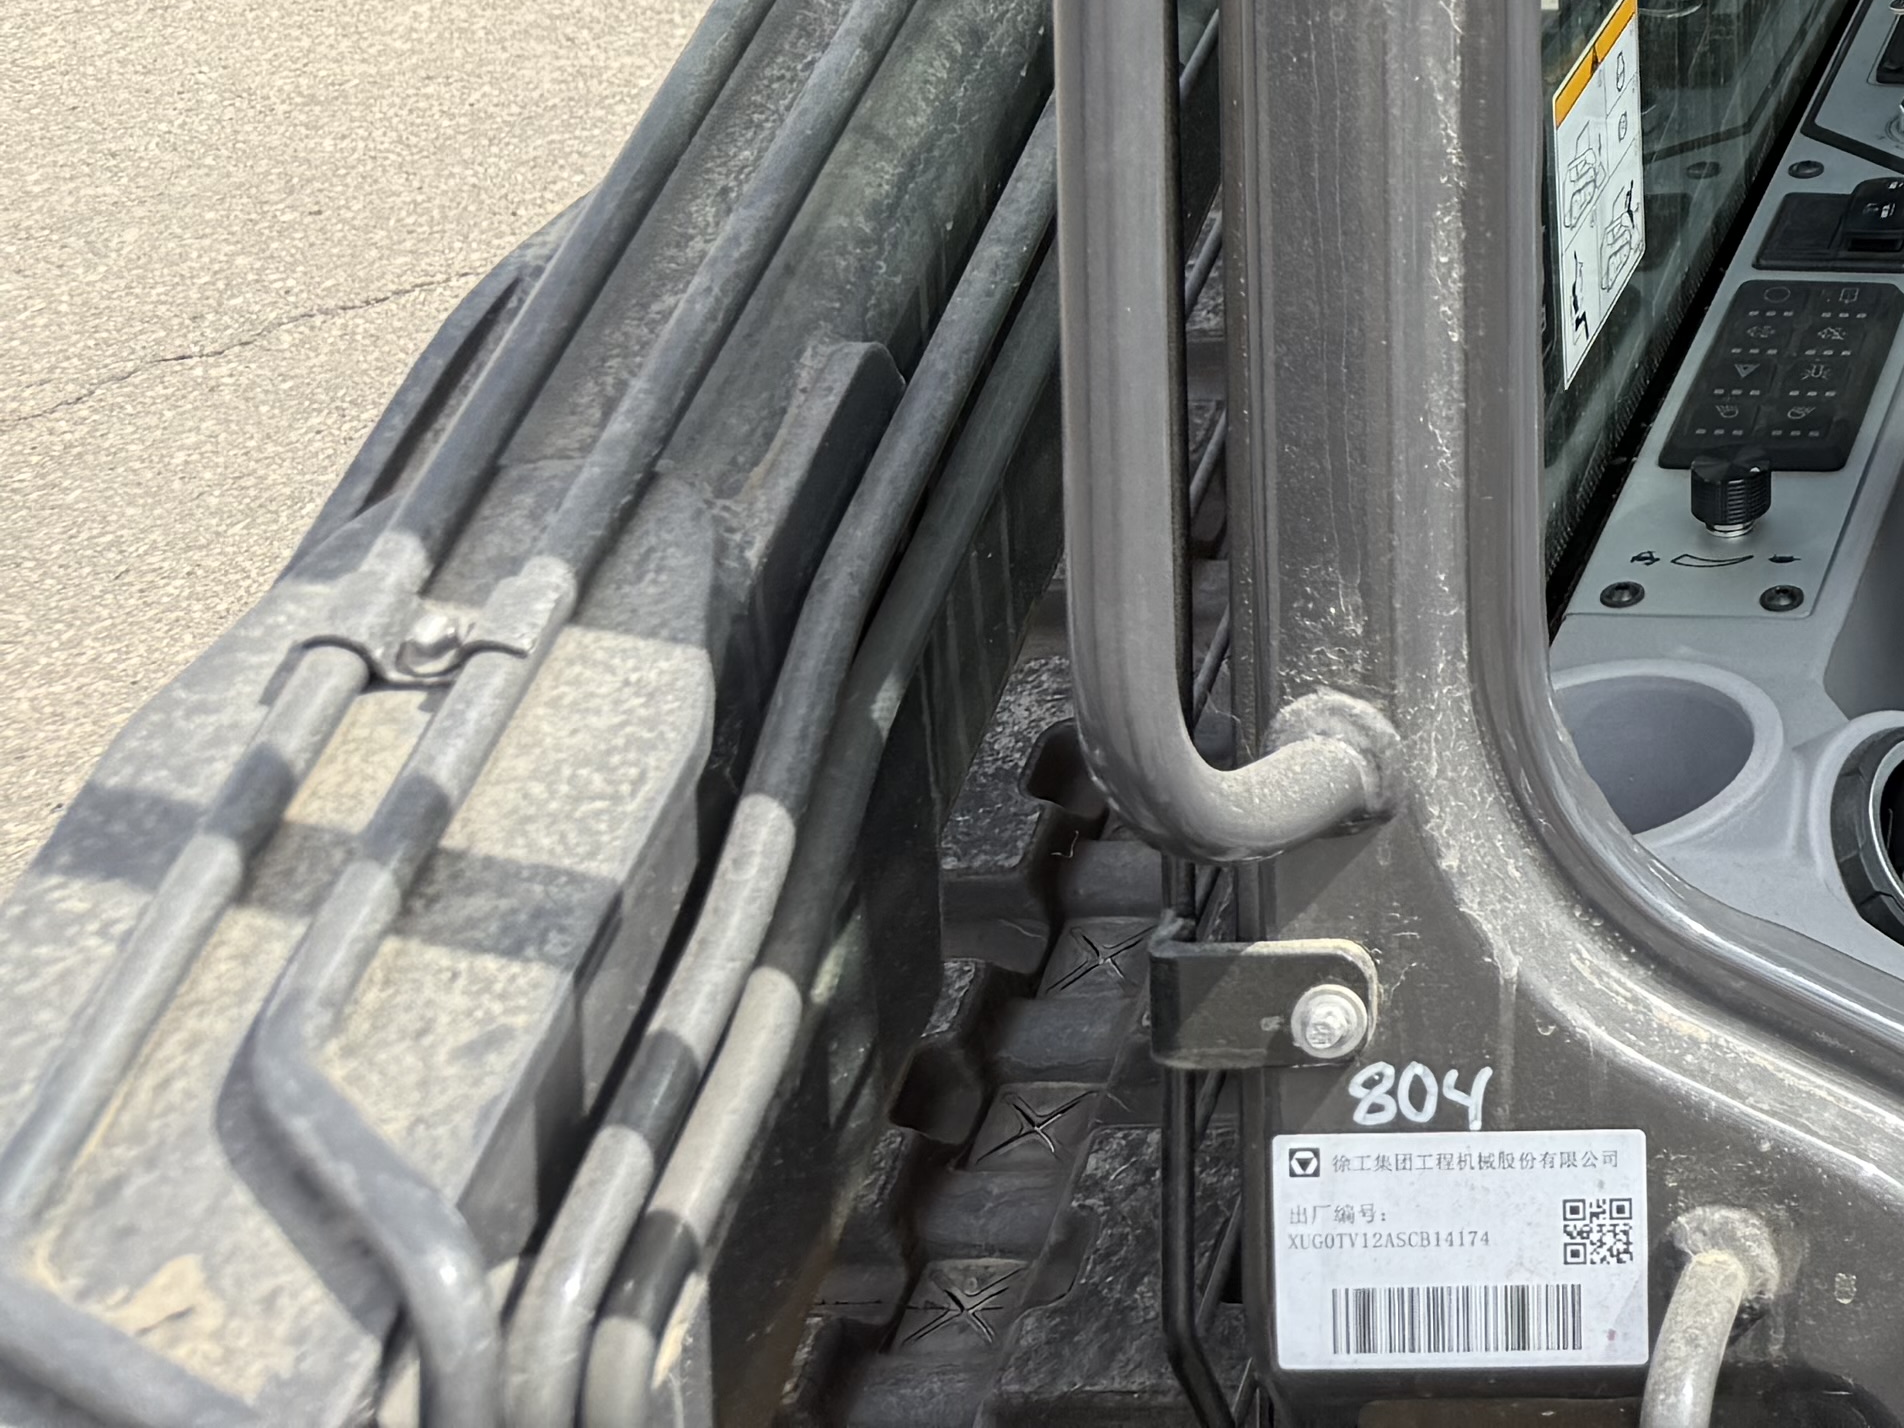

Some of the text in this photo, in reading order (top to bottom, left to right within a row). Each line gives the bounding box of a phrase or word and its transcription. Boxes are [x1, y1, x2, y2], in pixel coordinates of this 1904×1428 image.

[1348, 1060, 1494, 1131] 804
[1331, 1149, 1620, 1174] 徐工集团工程机械股份有限公司
